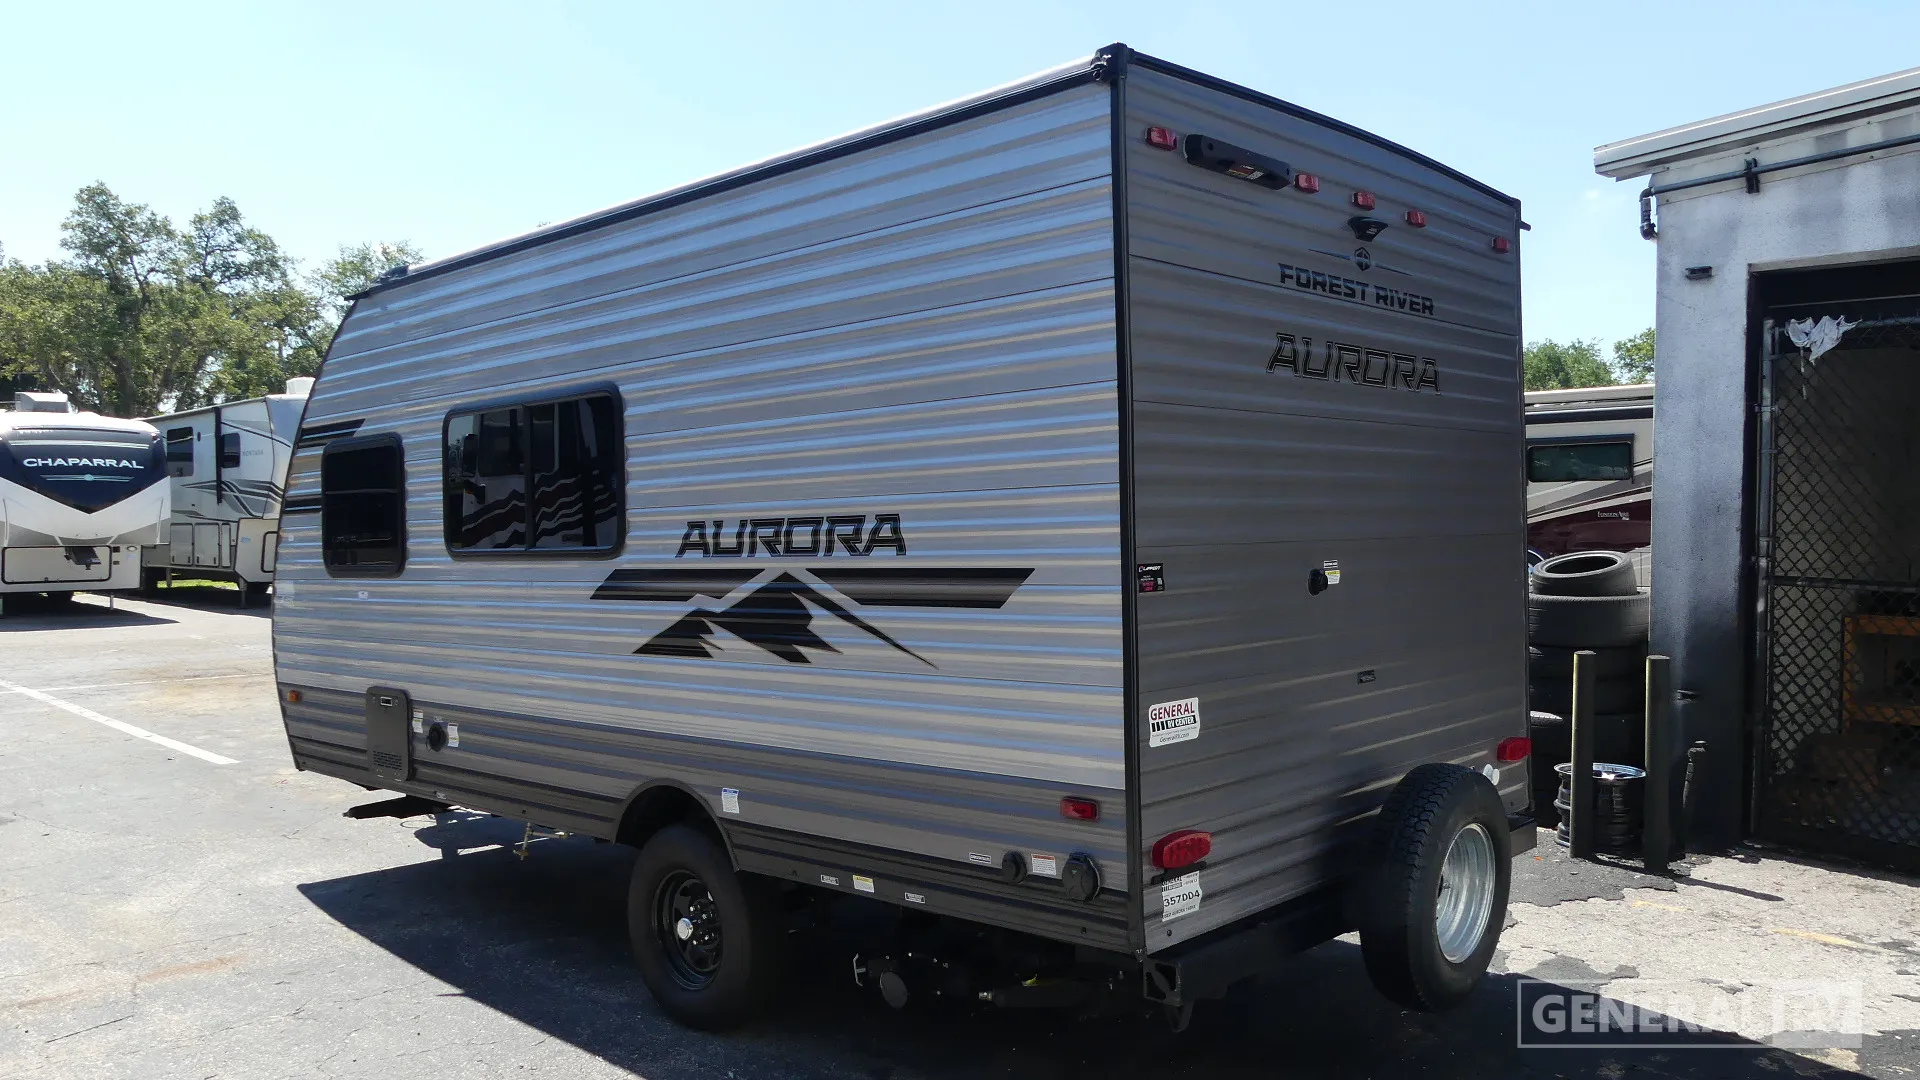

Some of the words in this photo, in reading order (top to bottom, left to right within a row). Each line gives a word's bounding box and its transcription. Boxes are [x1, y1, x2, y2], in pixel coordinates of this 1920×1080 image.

[1278, 263, 1369, 302] FOREST
[1374, 285, 1434, 316] RIVER
[1266, 332, 1442, 395] AURORA
[23, 458, 144, 469] CHAPARRAL
[675, 513, 907, 557] AURORA
[1151, 702, 1195, 721] GENERAL
[1175, 716, 1195, 727] CENTER
